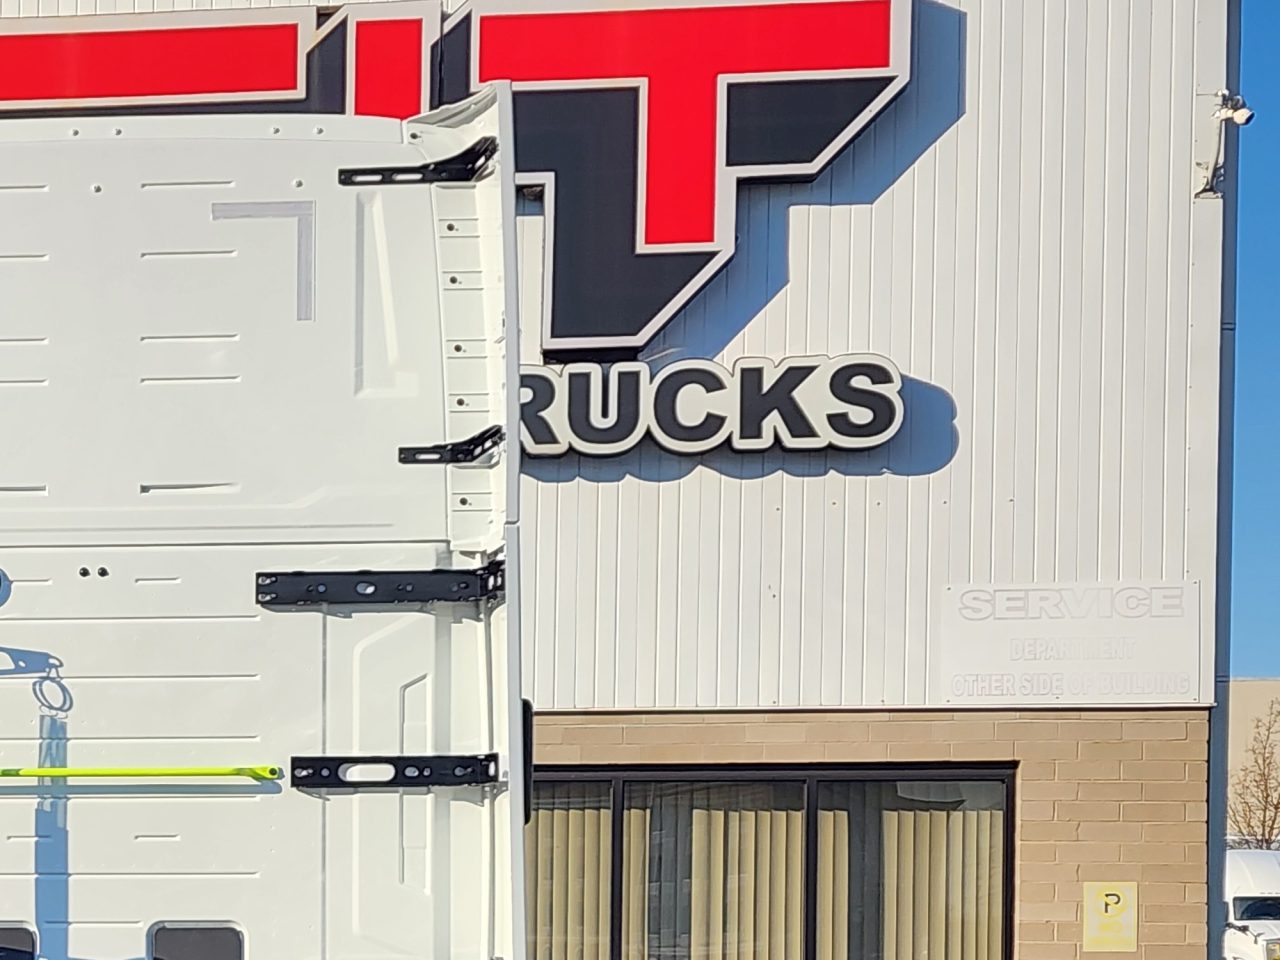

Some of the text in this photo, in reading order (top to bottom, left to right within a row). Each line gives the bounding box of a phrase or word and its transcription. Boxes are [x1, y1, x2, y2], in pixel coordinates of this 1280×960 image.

[958, 586, 1184, 621] SERVICE
[951, 673, 1017, 696] OTHER
[1019, 672, 1064, 696] SIDE
[1099, 671, 1190, 695] BUILDING
